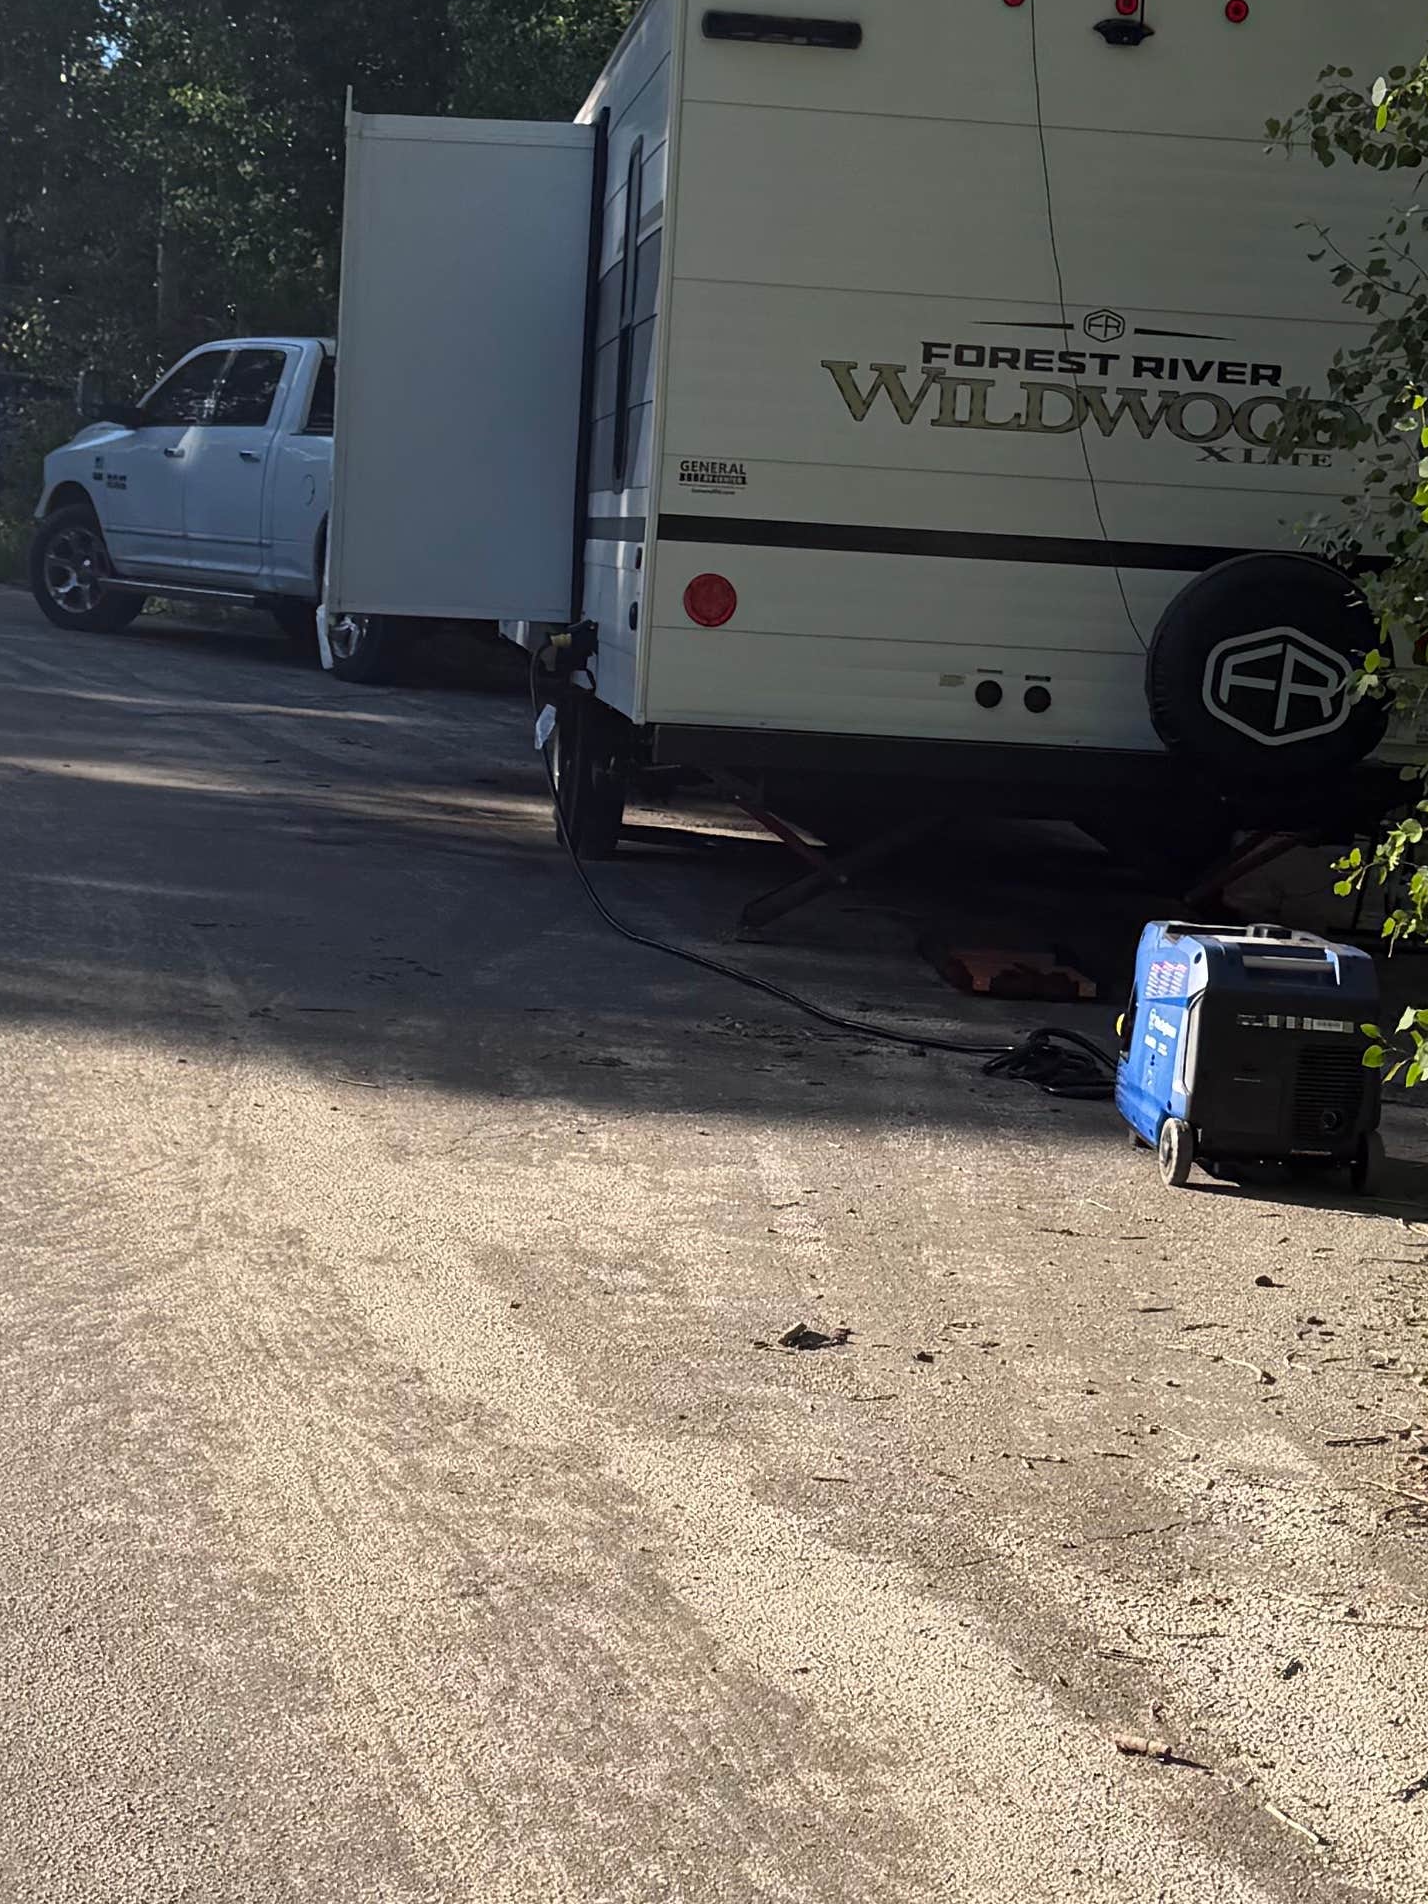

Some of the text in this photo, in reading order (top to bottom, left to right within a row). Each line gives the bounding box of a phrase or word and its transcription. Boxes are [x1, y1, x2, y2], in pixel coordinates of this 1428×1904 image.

[920, 341, 1282, 388] FOREST RIVER
[680, 460, 746, 475] GENERAL
[1219, 643, 1339, 730] FR
